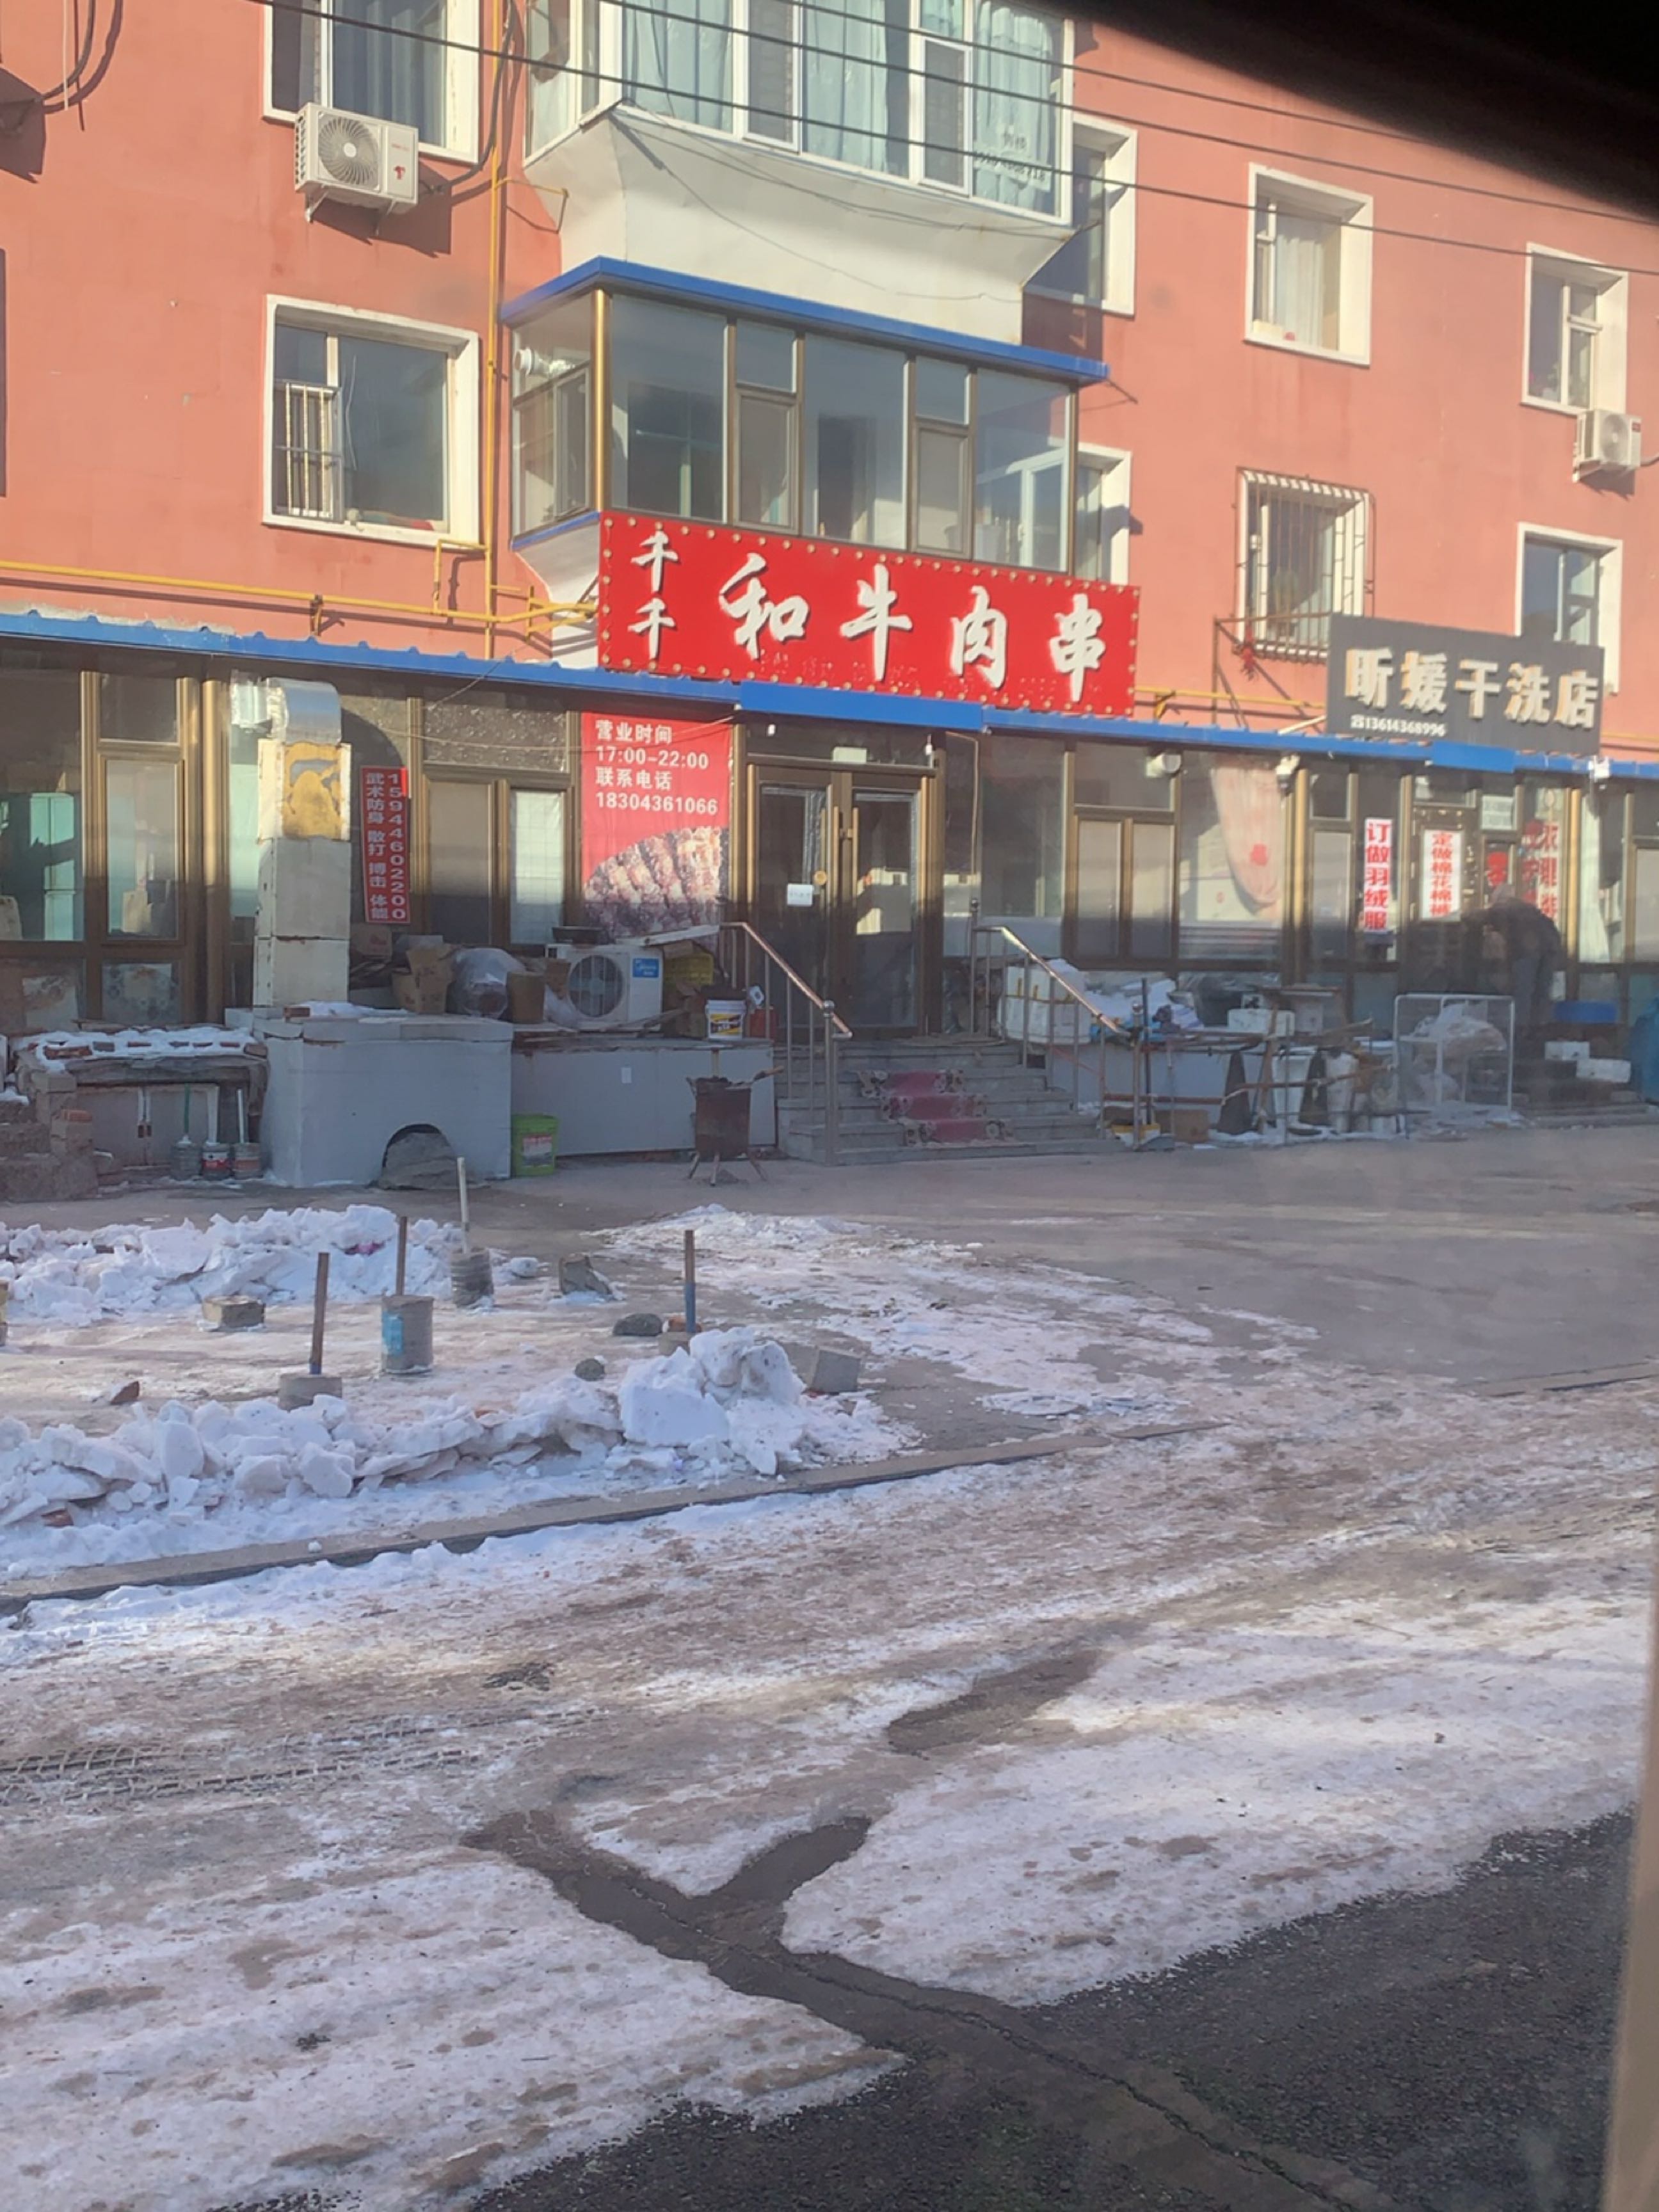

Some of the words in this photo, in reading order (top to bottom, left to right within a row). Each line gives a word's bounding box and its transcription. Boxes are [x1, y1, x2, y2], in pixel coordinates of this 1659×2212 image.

[627, 531, 678, 659] 千千
[718, 553, 1105, 703] 和牛肉串
[595, 719, 673, 744] 营业时间
[595, 746, 709, 769] 17:00-22:00
[595, 766, 673, 791] 联系电话
[596, 792, 718, 815] 18304361066
[388, 773, 406, 919] 15944602200
[1364, 822, 1391, 929] 订做羽绒服
